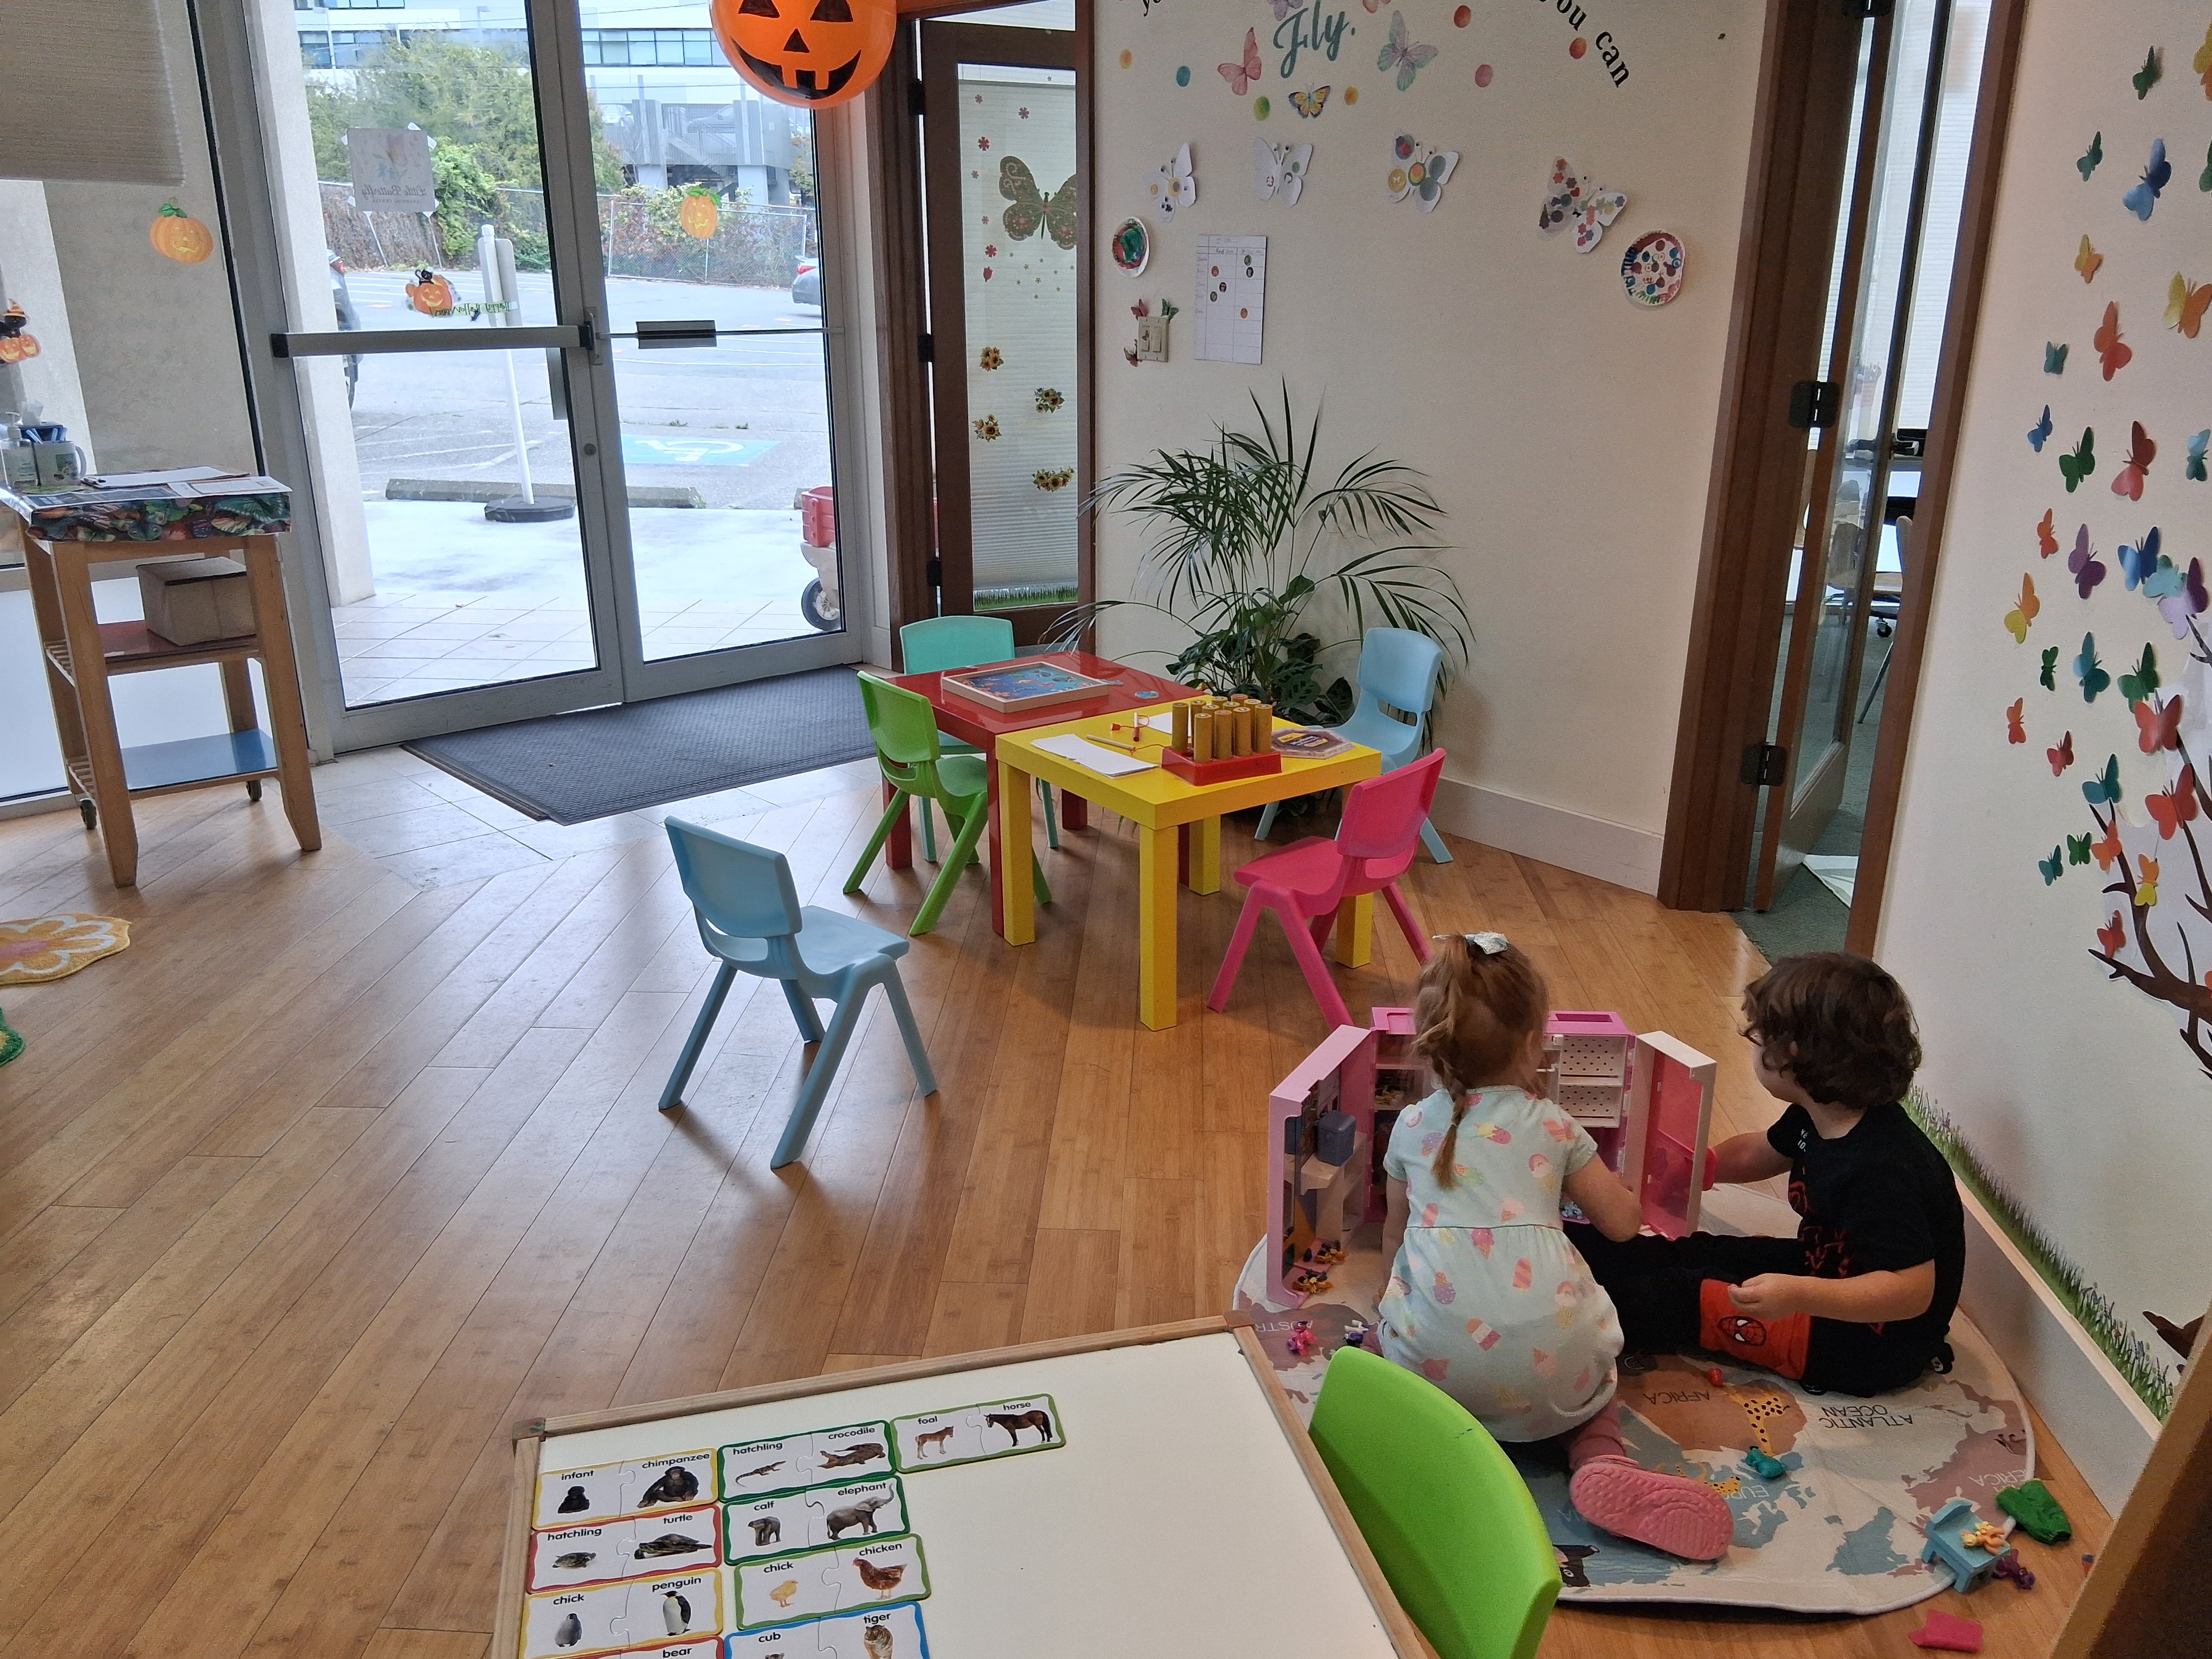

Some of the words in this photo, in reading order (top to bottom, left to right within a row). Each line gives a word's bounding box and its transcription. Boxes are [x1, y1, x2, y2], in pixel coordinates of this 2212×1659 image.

[1539, 0, 1587, 31] ou
[1596, 31, 1629, 88] can
[1643, 1390, 1711, 1405] AFRICA
[1003, 1401, 1031, 1411] horse
[1821, 1404, 1888, 1418] OCEAN
[917, 1416, 938, 1425] foal
[1818, 1413, 1914, 1429] ATLANTIC
[828, 1427, 875, 1440] crocodile
[733, 1442, 783, 1455] hatchling
[642, 1453, 710, 1469] chimpanzee
[561, 1470, 594, 1481] infant
[838, 1482, 887, 1496] elephant
[754, 1501, 775, 1511] calf
[663, 1514, 693, 1524] turtle
[548, 1528, 602, 1541] hatchling
[859, 1542, 902, 1557] chicken
[763, 1561, 794, 1573] chick
[652, 1577, 701, 1592] penguin
[553, 1593, 584, 1605] chick
[863, 1612, 891, 1624] tiger
[758, 1631, 781, 1643] cub
[663, 1647, 692, 1658] bear
